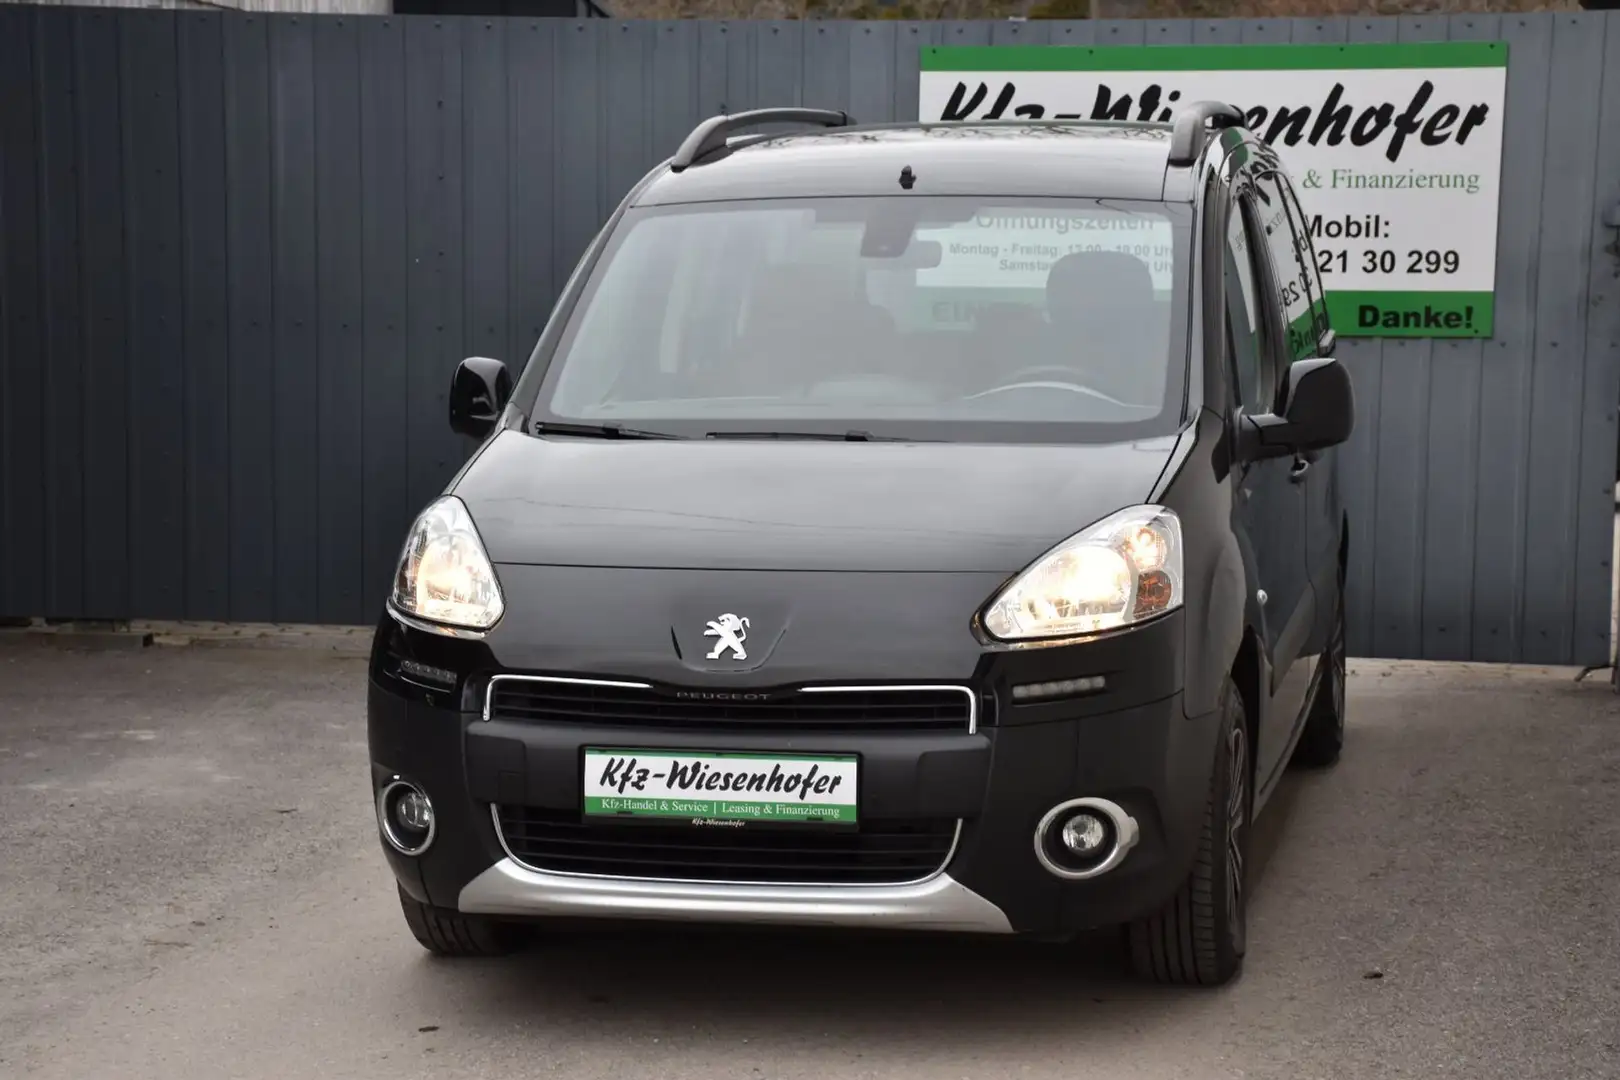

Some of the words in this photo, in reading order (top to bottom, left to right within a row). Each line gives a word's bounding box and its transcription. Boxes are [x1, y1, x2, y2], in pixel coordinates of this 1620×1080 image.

[940, 80, 1488, 162] K-Wienhofer
[1302, 169, 1323, 190] &
[1331, 168, 1481, 194] Finanzierung
[949, 243, 999, 258] Montag
[1361, 249, 1396, 274] 30
[1406, 249, 1460, 274] 299
[1358, 305, 1474, 329] Danke!
[676, 691, 772, 701] PEUGEOT
[599, 757, 842, 801] Kfz-Wiesenhofer
[601, 798, 657, 811] Kfz-Handel
[660, 800, 669, 811] &
[671, 801, 709, 812] Service
[722, 802, 761, 816] Leasing
[763, 804, 772, 814] &
[775, 804, 840, 819] Finanzierung
